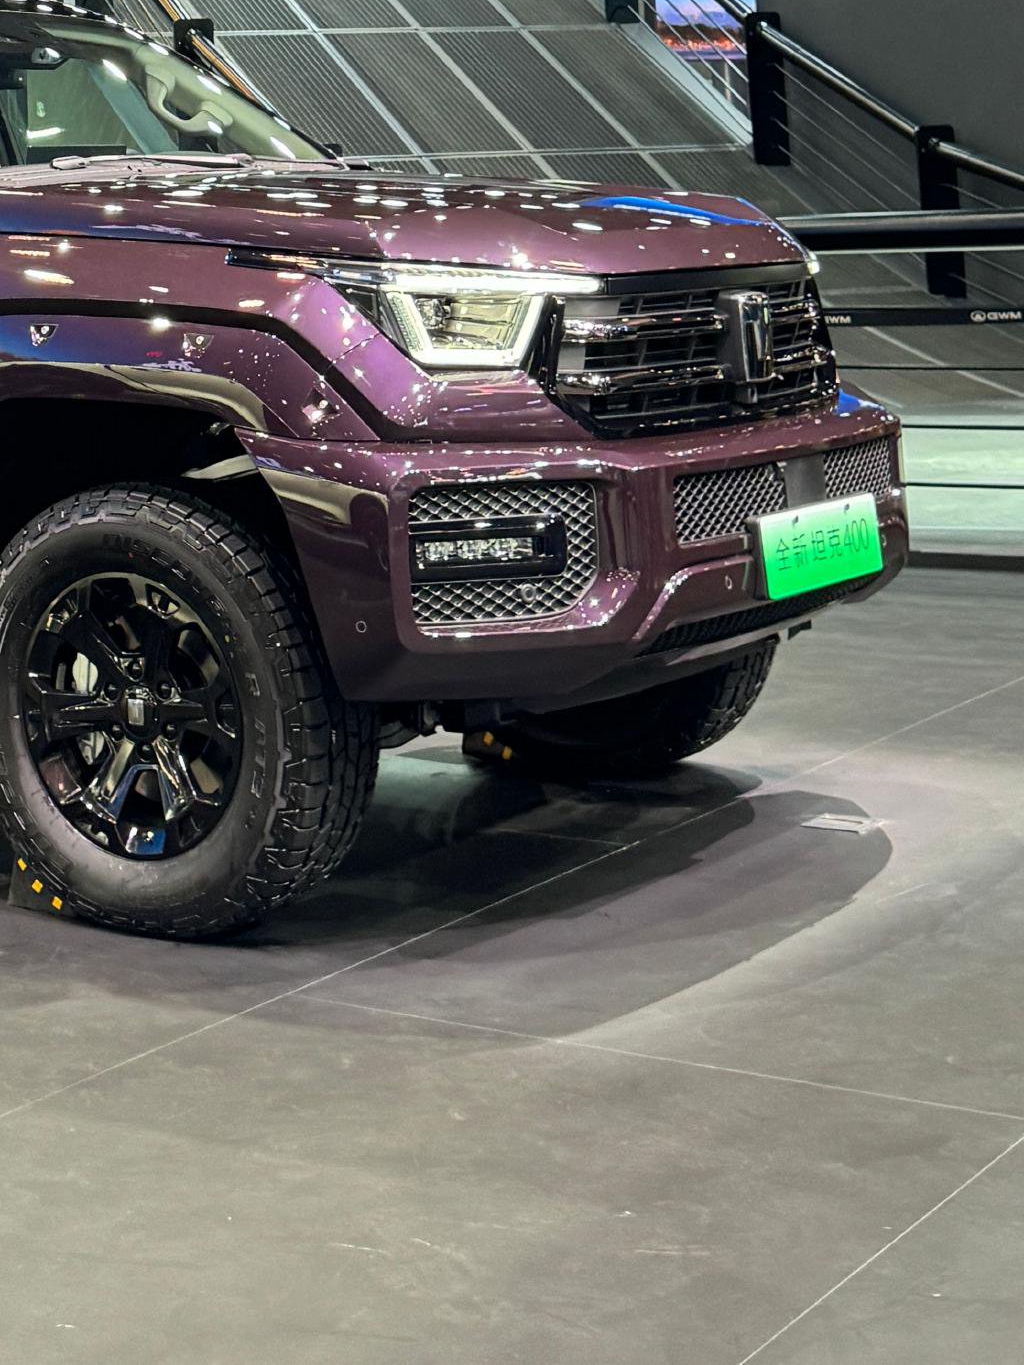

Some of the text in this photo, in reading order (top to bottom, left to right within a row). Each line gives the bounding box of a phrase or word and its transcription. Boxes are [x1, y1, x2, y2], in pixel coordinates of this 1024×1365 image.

[987, 311, 1022, 321] GWM
[776, 518, 870, 571] 全新坦克400
